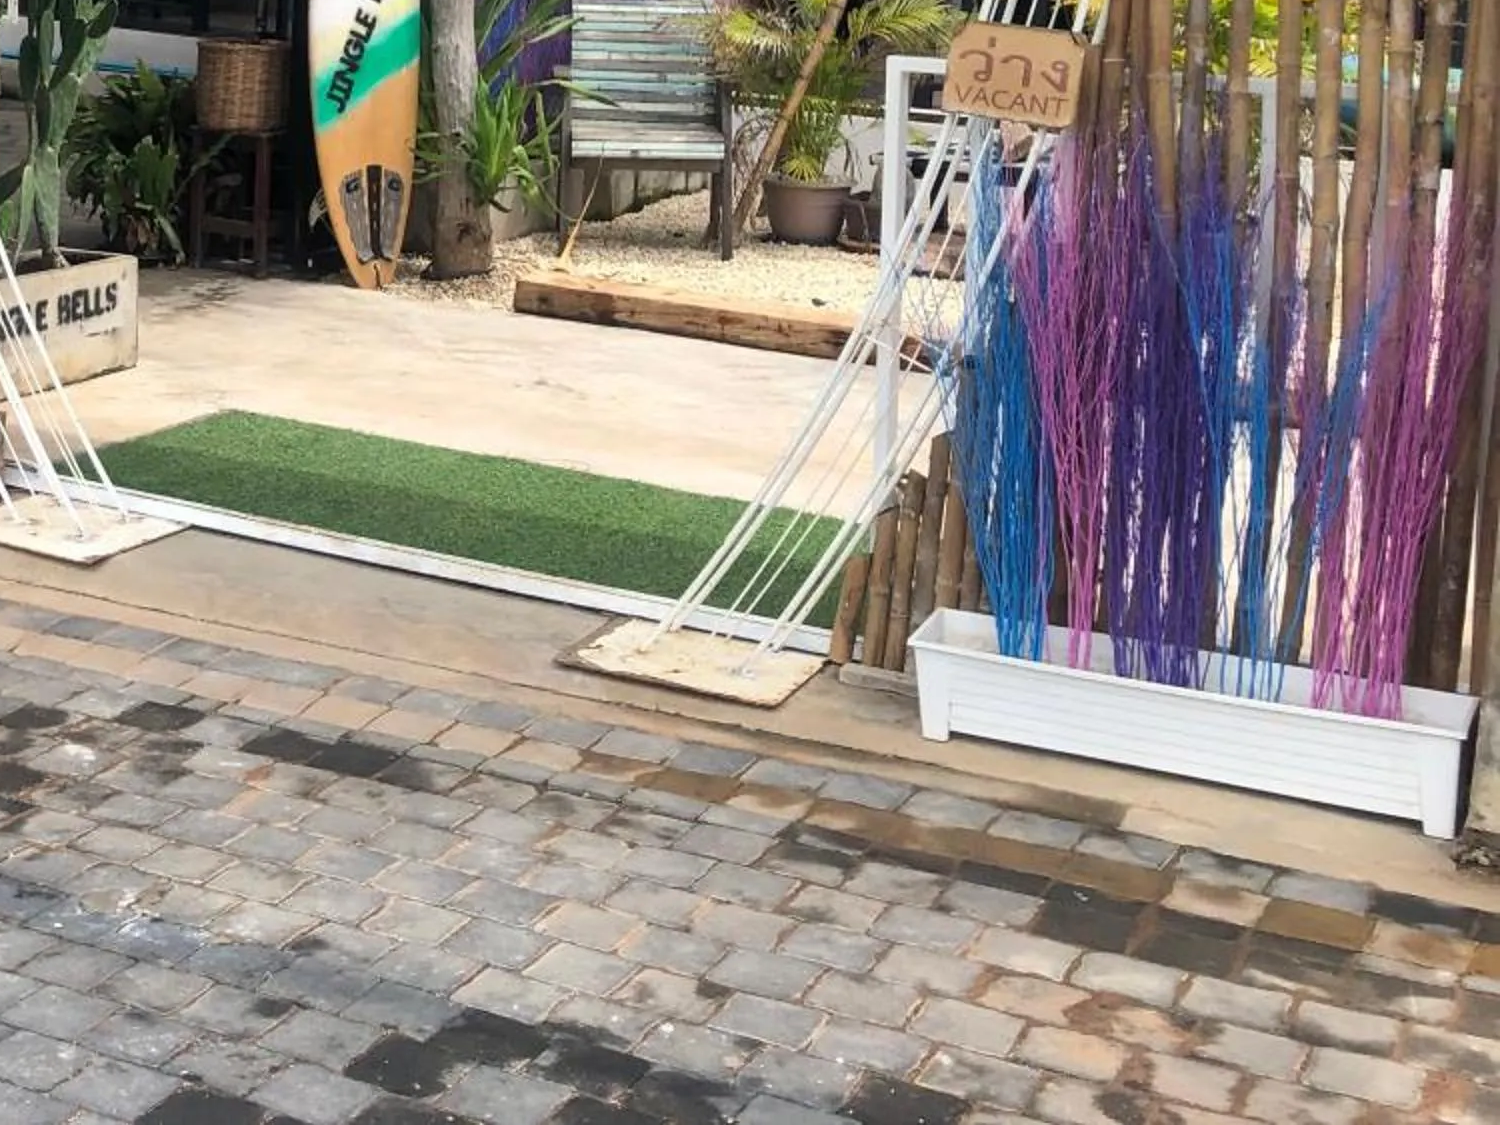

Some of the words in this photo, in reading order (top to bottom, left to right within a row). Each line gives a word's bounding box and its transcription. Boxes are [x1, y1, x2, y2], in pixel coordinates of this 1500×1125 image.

[326, 8, 377, 114] JINGLE
[959, 36, 1070, 94] ว่าง
[955, 82, 1070, 119] VACANT
[57, 282, 118, 326] BELLS
